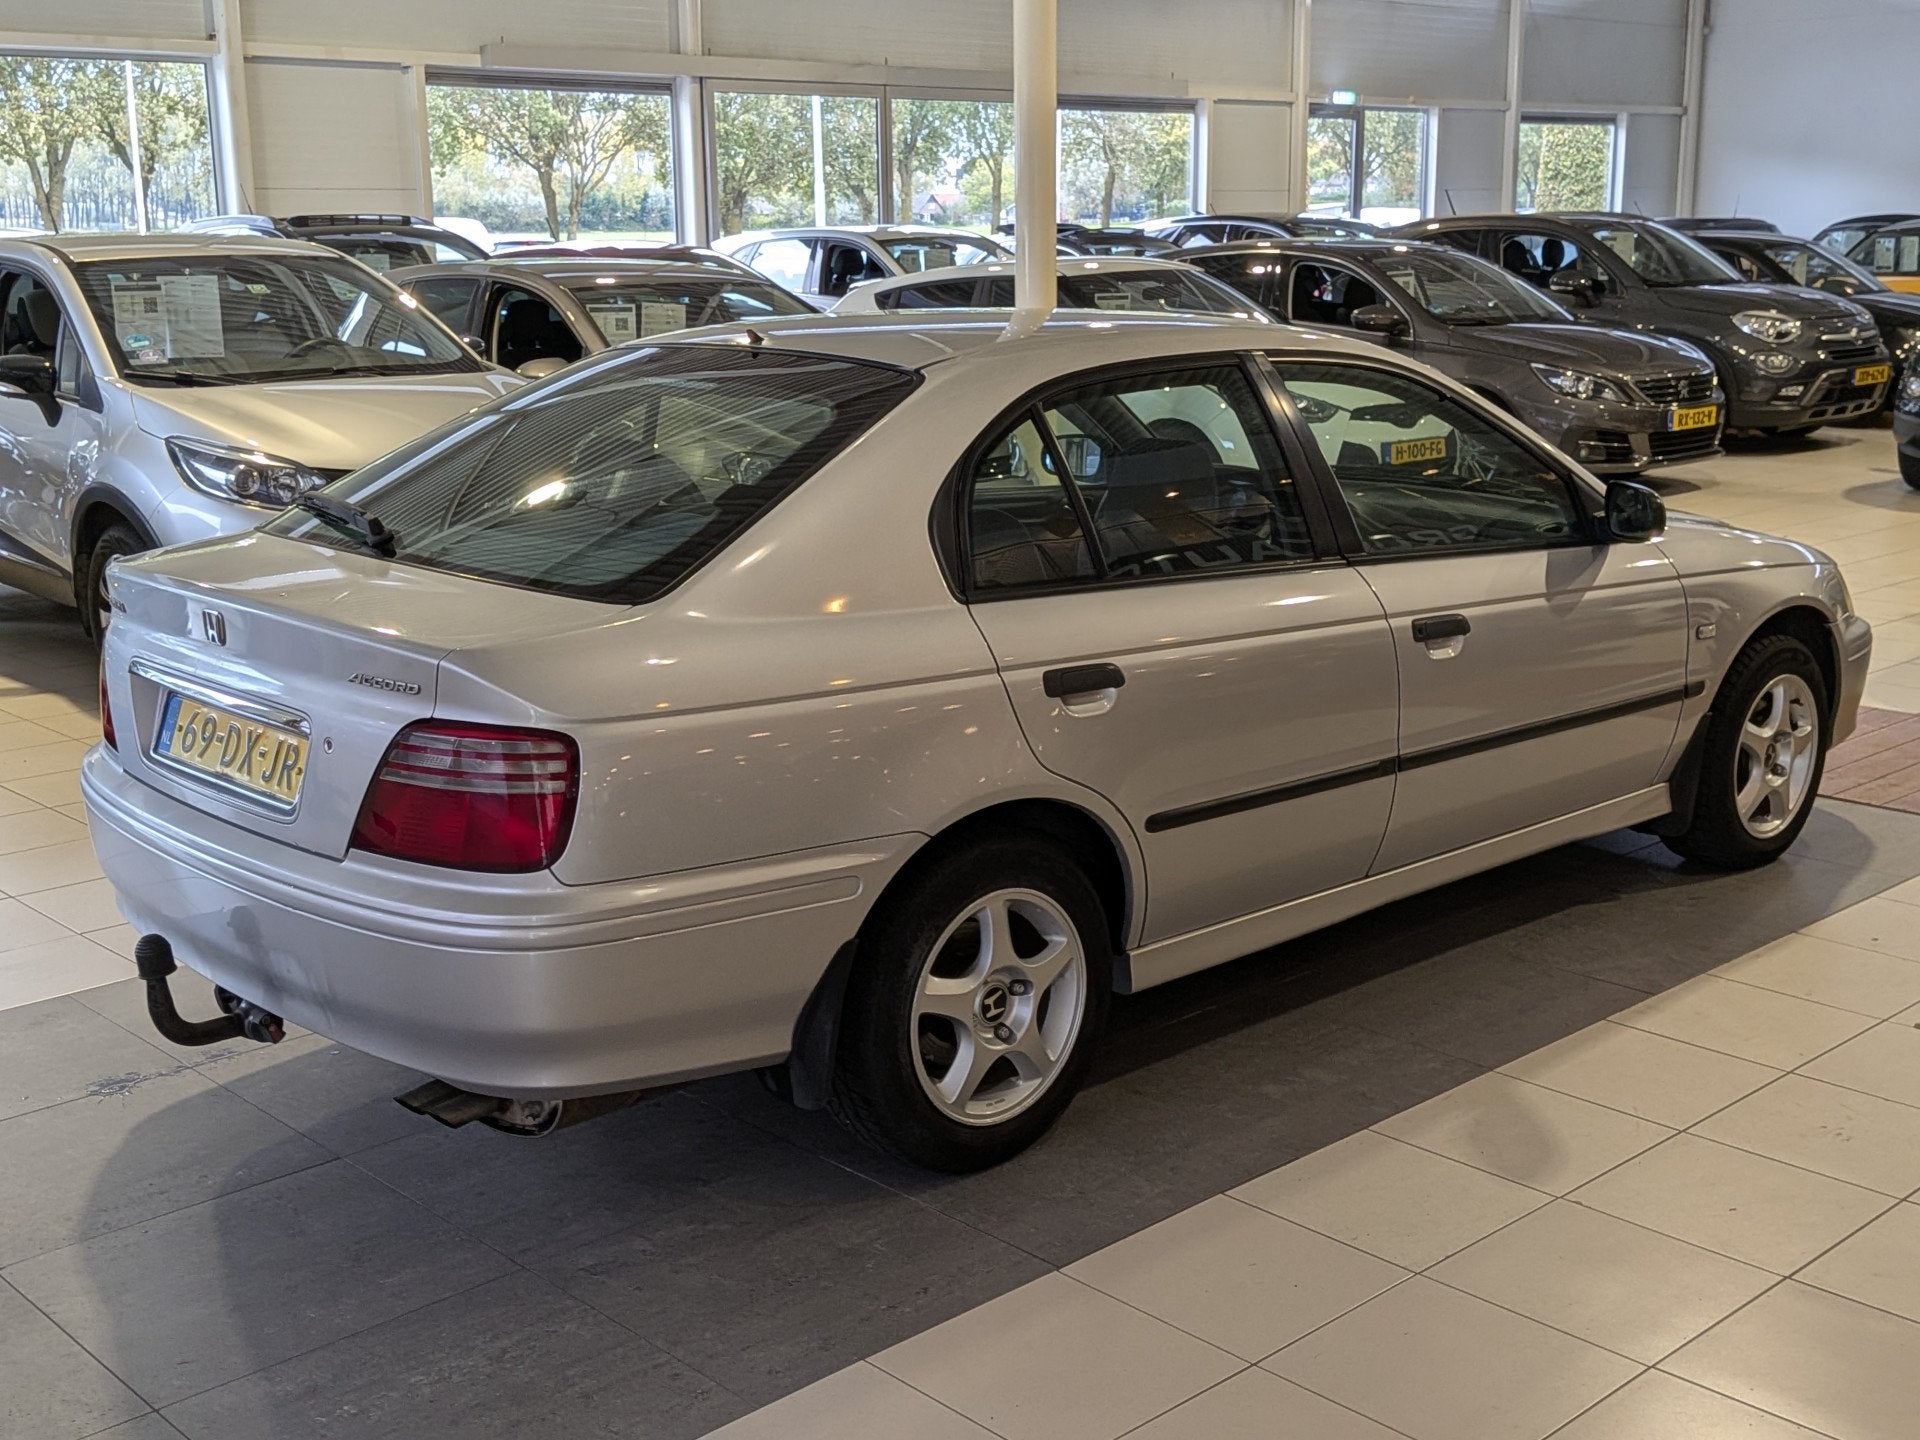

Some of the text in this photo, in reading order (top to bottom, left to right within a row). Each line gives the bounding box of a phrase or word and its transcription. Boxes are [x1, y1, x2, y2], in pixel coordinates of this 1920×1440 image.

[1395, 440, 1443, 461] H-100-FG
[346, 672, 422, 695] ACCORD
[181, 709, 300, 791] 69-DX-JR
